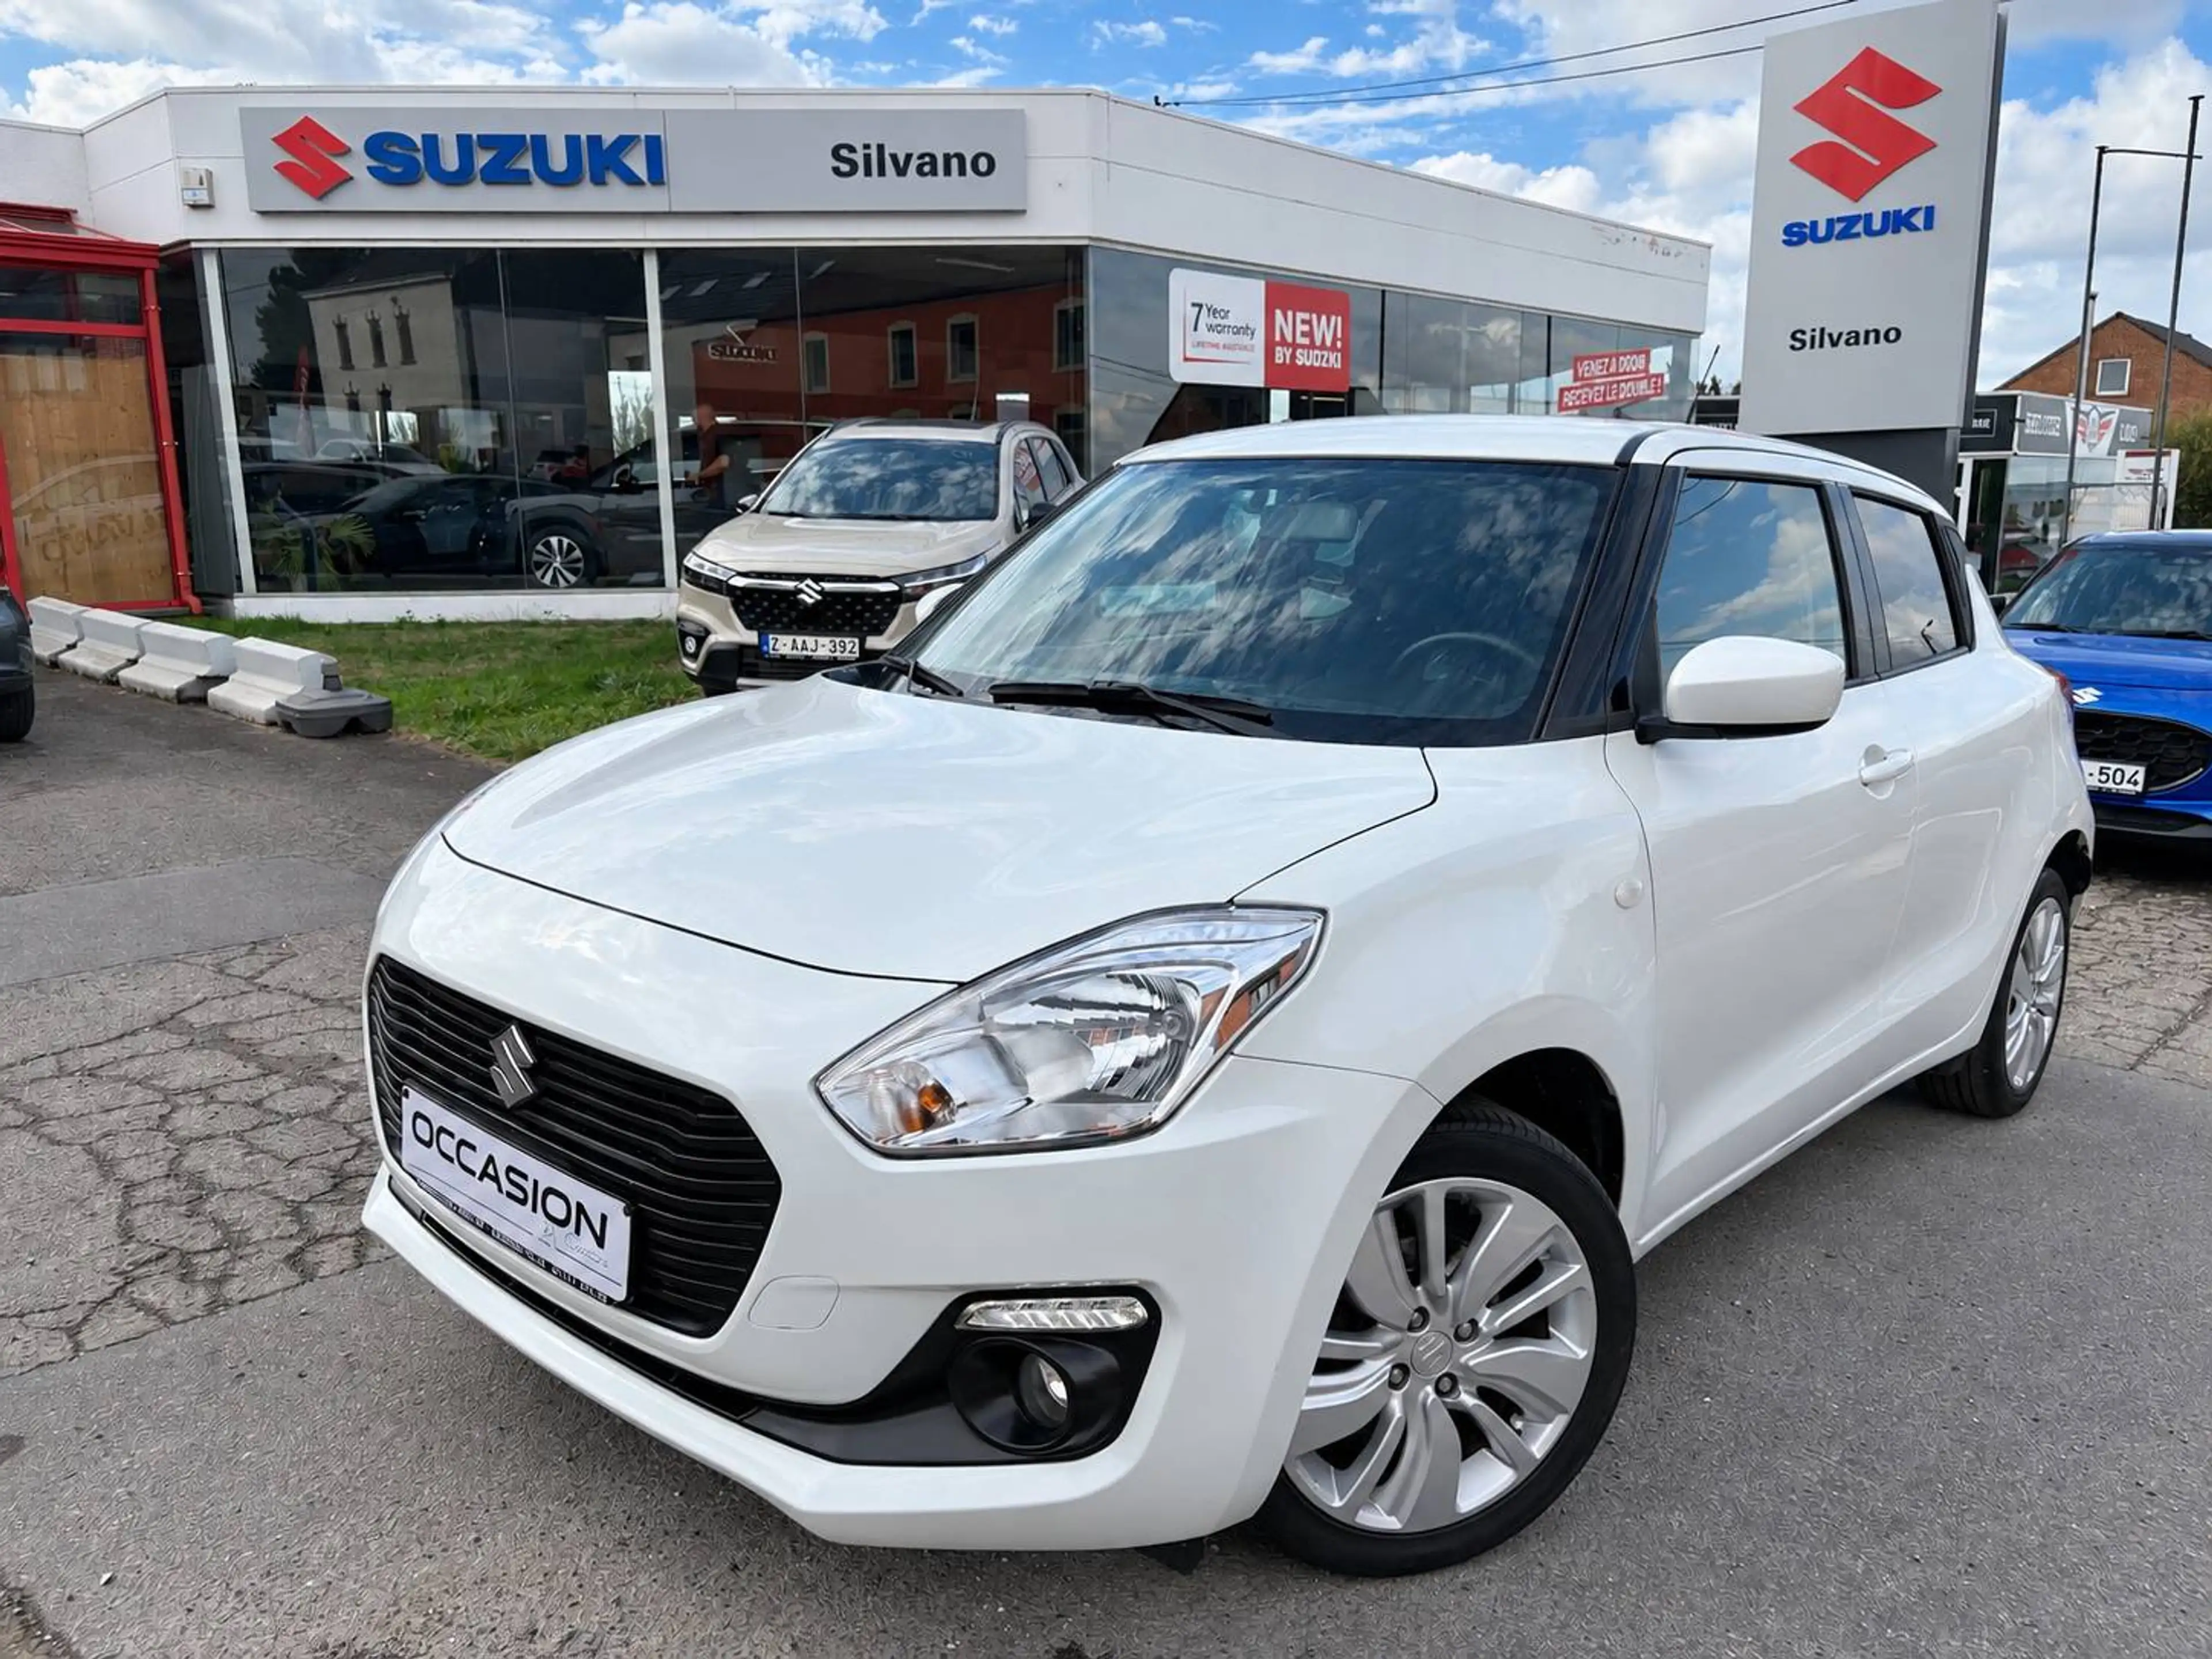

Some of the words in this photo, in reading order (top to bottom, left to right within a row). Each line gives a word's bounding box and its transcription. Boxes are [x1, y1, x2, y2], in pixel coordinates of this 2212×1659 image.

[363, 131, 666, 187] SUZUKI
[830, 142, 997, 179] Silvano
[1781, 204, 1936, 247] SUZUKI
[1191, 302, 1203, 332] 7
[1205, 303, 1230, 320] Year
[1205, 322, 1257, 341] warranty
[1274, 308, 1342, 349] NEW!
[1275, 346, 1293, 365] BY
[1789, 326, 1902, 352] Silvano
[411, 1109, 608, 1250] OCCASION
